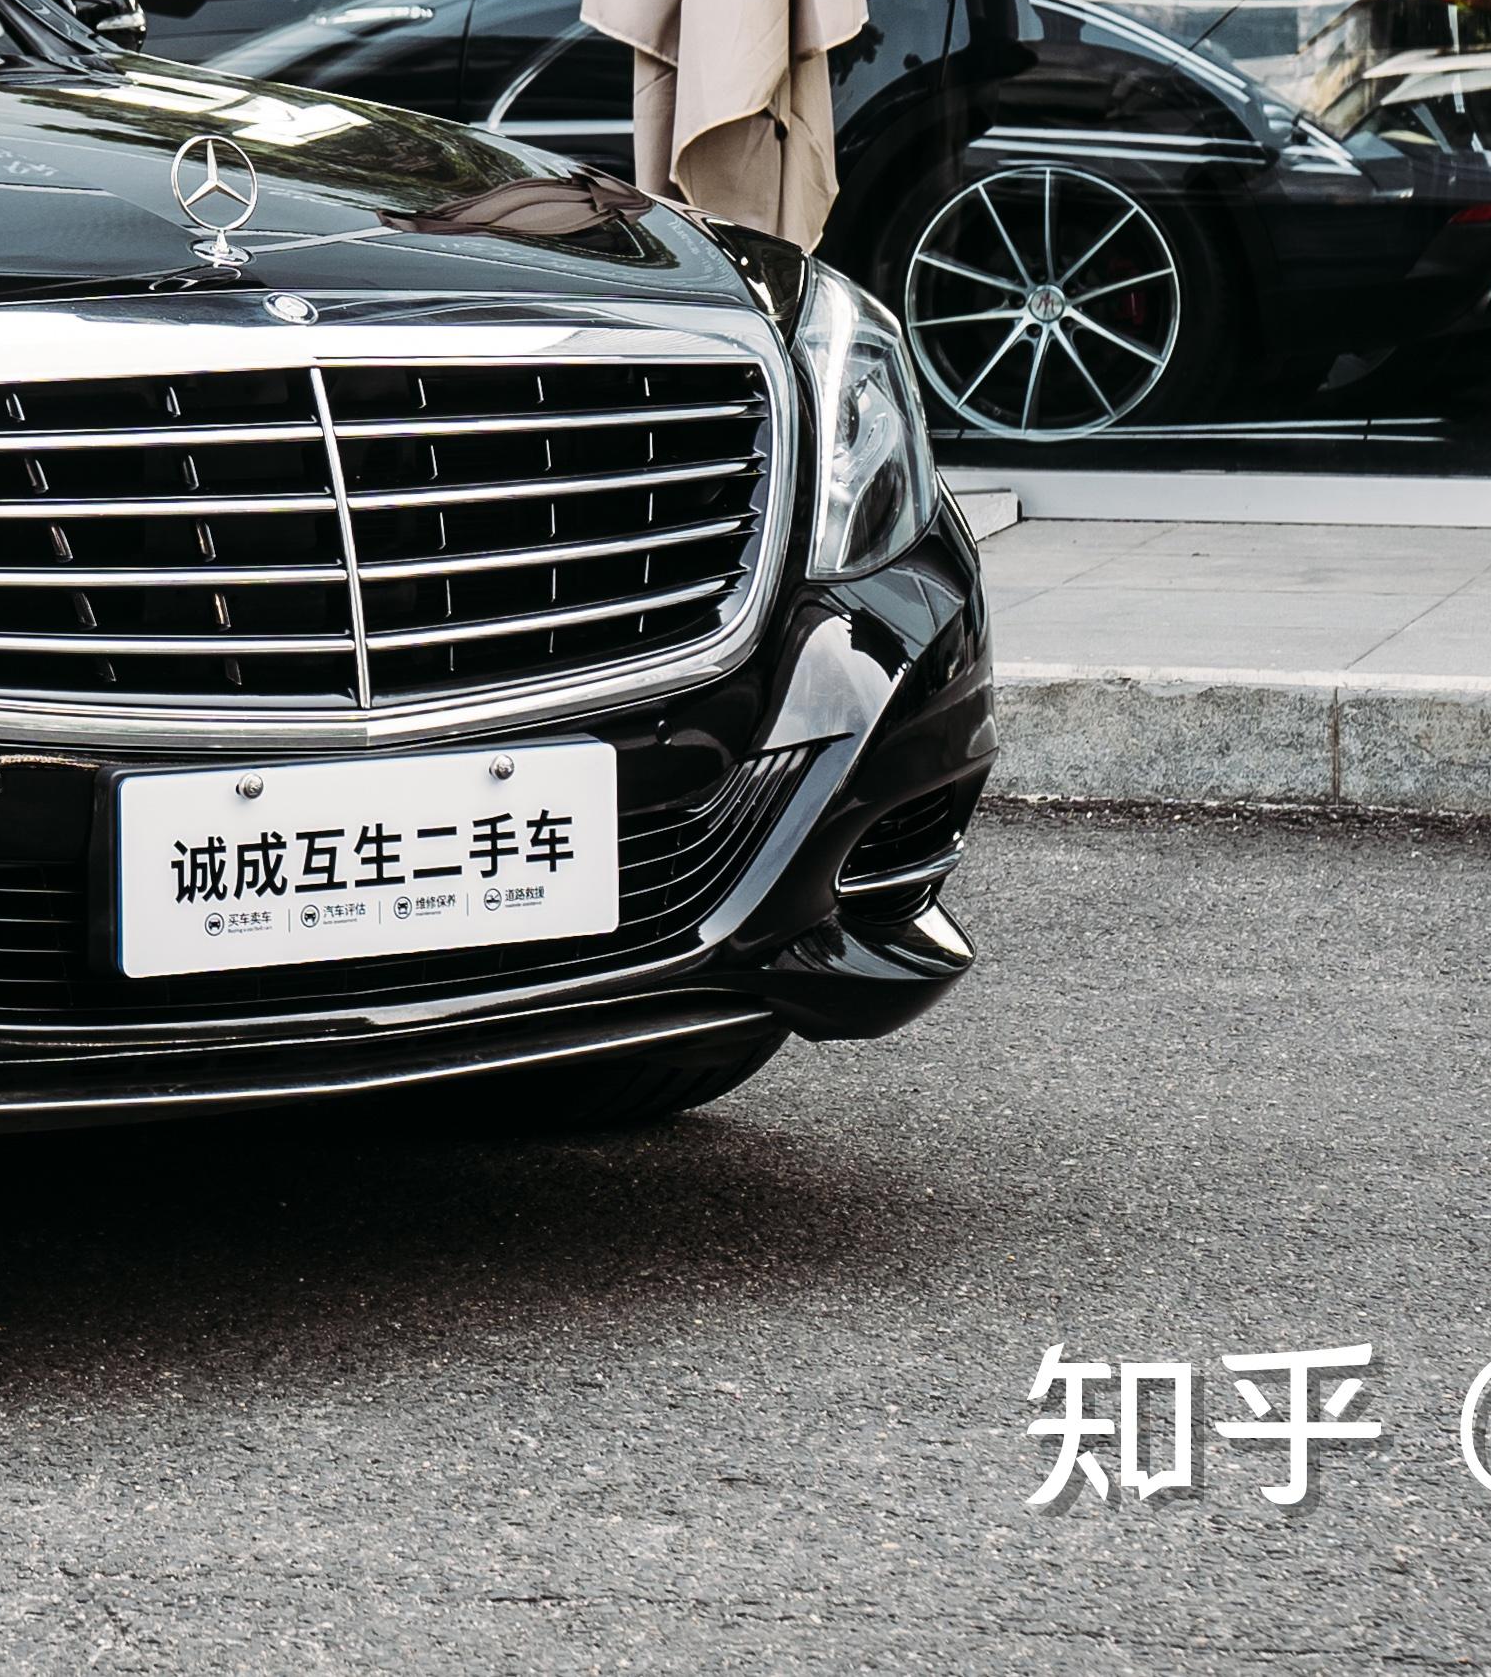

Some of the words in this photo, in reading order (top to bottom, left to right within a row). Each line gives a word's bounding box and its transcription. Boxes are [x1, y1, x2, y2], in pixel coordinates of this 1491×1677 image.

[170, 809, 575, 905] 诚成互生二手车
[416, 893, 456, 910] 维修保养
[505, 886, 546, 902] 道路救援
[323, 902, 366, 918] 汽车评估
[228, 911, 272, 927] 买车卖车
